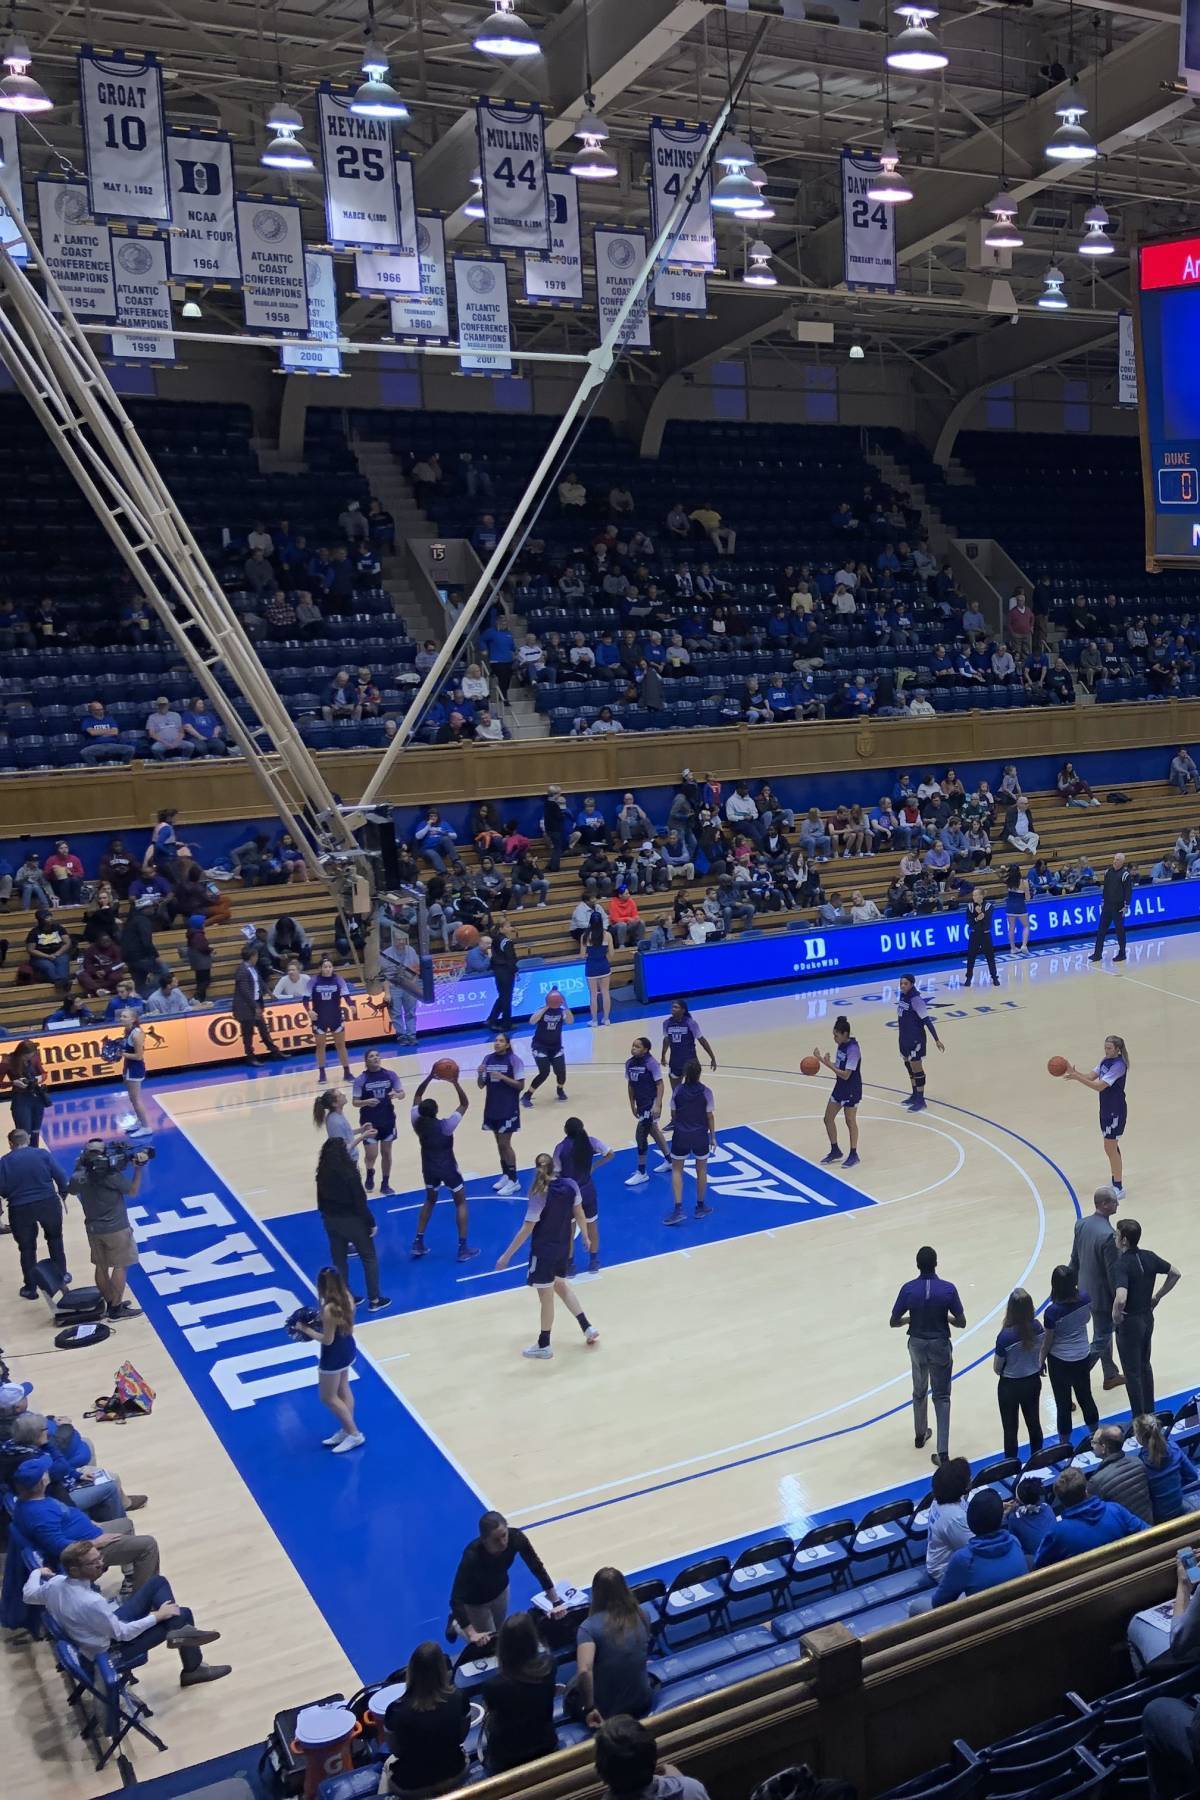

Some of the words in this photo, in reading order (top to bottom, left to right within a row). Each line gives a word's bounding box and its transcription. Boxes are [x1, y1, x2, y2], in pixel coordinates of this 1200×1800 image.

[98, 82, 147, 109] GROAT
[103, 113, 147, 151] 10
[327, 115, 387, 141] HEYMAN
[486, 127, 539, 153] MULLINS
[336, 145, 385, 182] 25
[493, 157, 537, 191] 44
[103, 182, 122, 193] MAY
[188, 210, 218, 223] NCAA
[852, 199, 888, 230] 24
[206, 231, 234, 242] FOUR
[61, 247, 94, 258] COAST
[251, 251, 294, 263] ATLANTIC
[47, 257, 111, 271] CONFERENCE
[193, 259, 220, 270] 1964
[259, 264, 288, 274] COAST
[51, 270, 109, 283] CHAMPIONS
[245, 274, 303, 287] CONFERENCE
[377, 272, 402, 283] 1966
[117, 284, 159, 296] ATLANTIC
[544, 280, 567, 290] 1978
[248, 286, 302, 298] CHAMPIONS
[611, 287, 631, 296] COAS
[671, 291, 692, 302] 1986
[68, 298, 96, 308] 1954
[125, 296, 154, 306] COAST
[117, 306, 169, 318] ONFERENCE
[466, 303, 500, 312] ATLANTIC
[265, 312, 290, 323] 1958
[472, 313, 496, 322] COAST
[409, 319, 432, 329] 1960
[460, 322, 508, 333] CONFERENCE
[463, 333, 507, 343] CHAMPIONS
[131, 343, 157, 352] 1999
[300, 352, 323, 362] 2000
[1164, 452, 1191, 466] DUKE
[1181, 472, 1192, 500] 0
[433, 549, 444, 559] 15
[880, 927, 935, 953] DUKE
[539, 977, 584, 994] REEDS
[127, 1192, 361, 1411] DUKE
[324, 1755, 344, 1774] G
